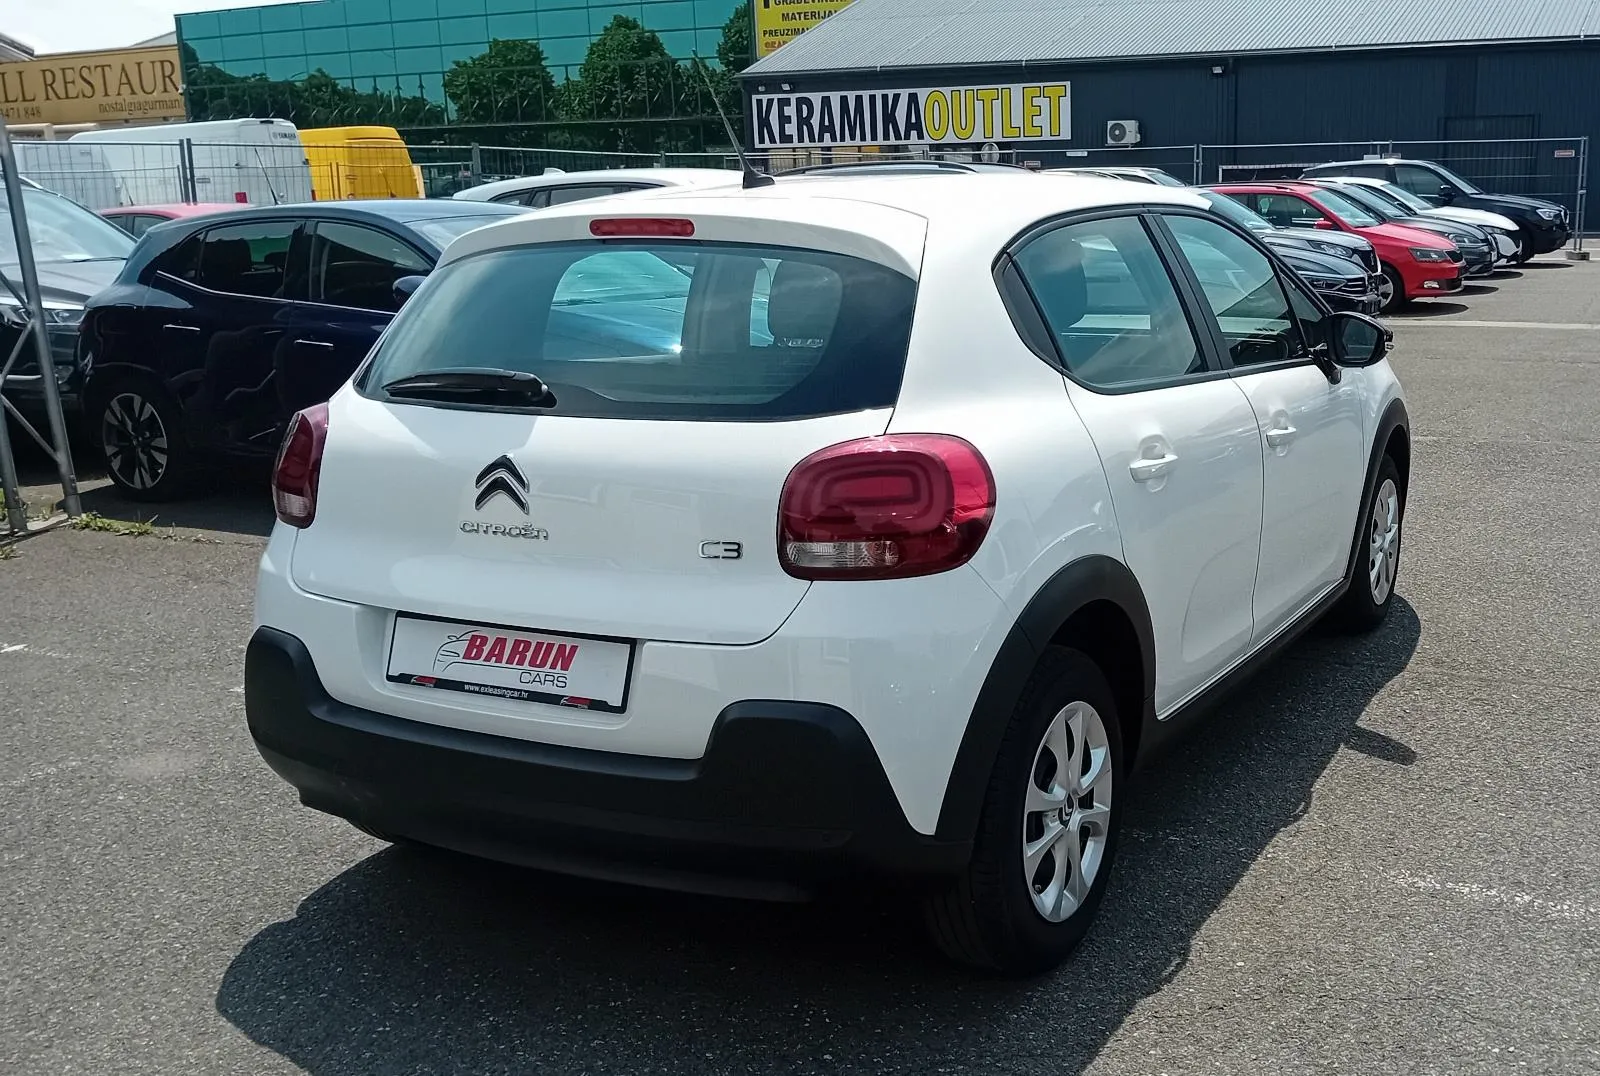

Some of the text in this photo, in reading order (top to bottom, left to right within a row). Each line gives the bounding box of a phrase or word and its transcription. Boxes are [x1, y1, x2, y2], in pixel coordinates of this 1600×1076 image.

[40, 59, 180, 101] RESTAUR
[698, 540, 744, 560] C3
[462, 634, 579, 672] BARUN
[519, 671, 568, 689] CARS
[464, 684, 529, 699] www.exleasingcar.hr
